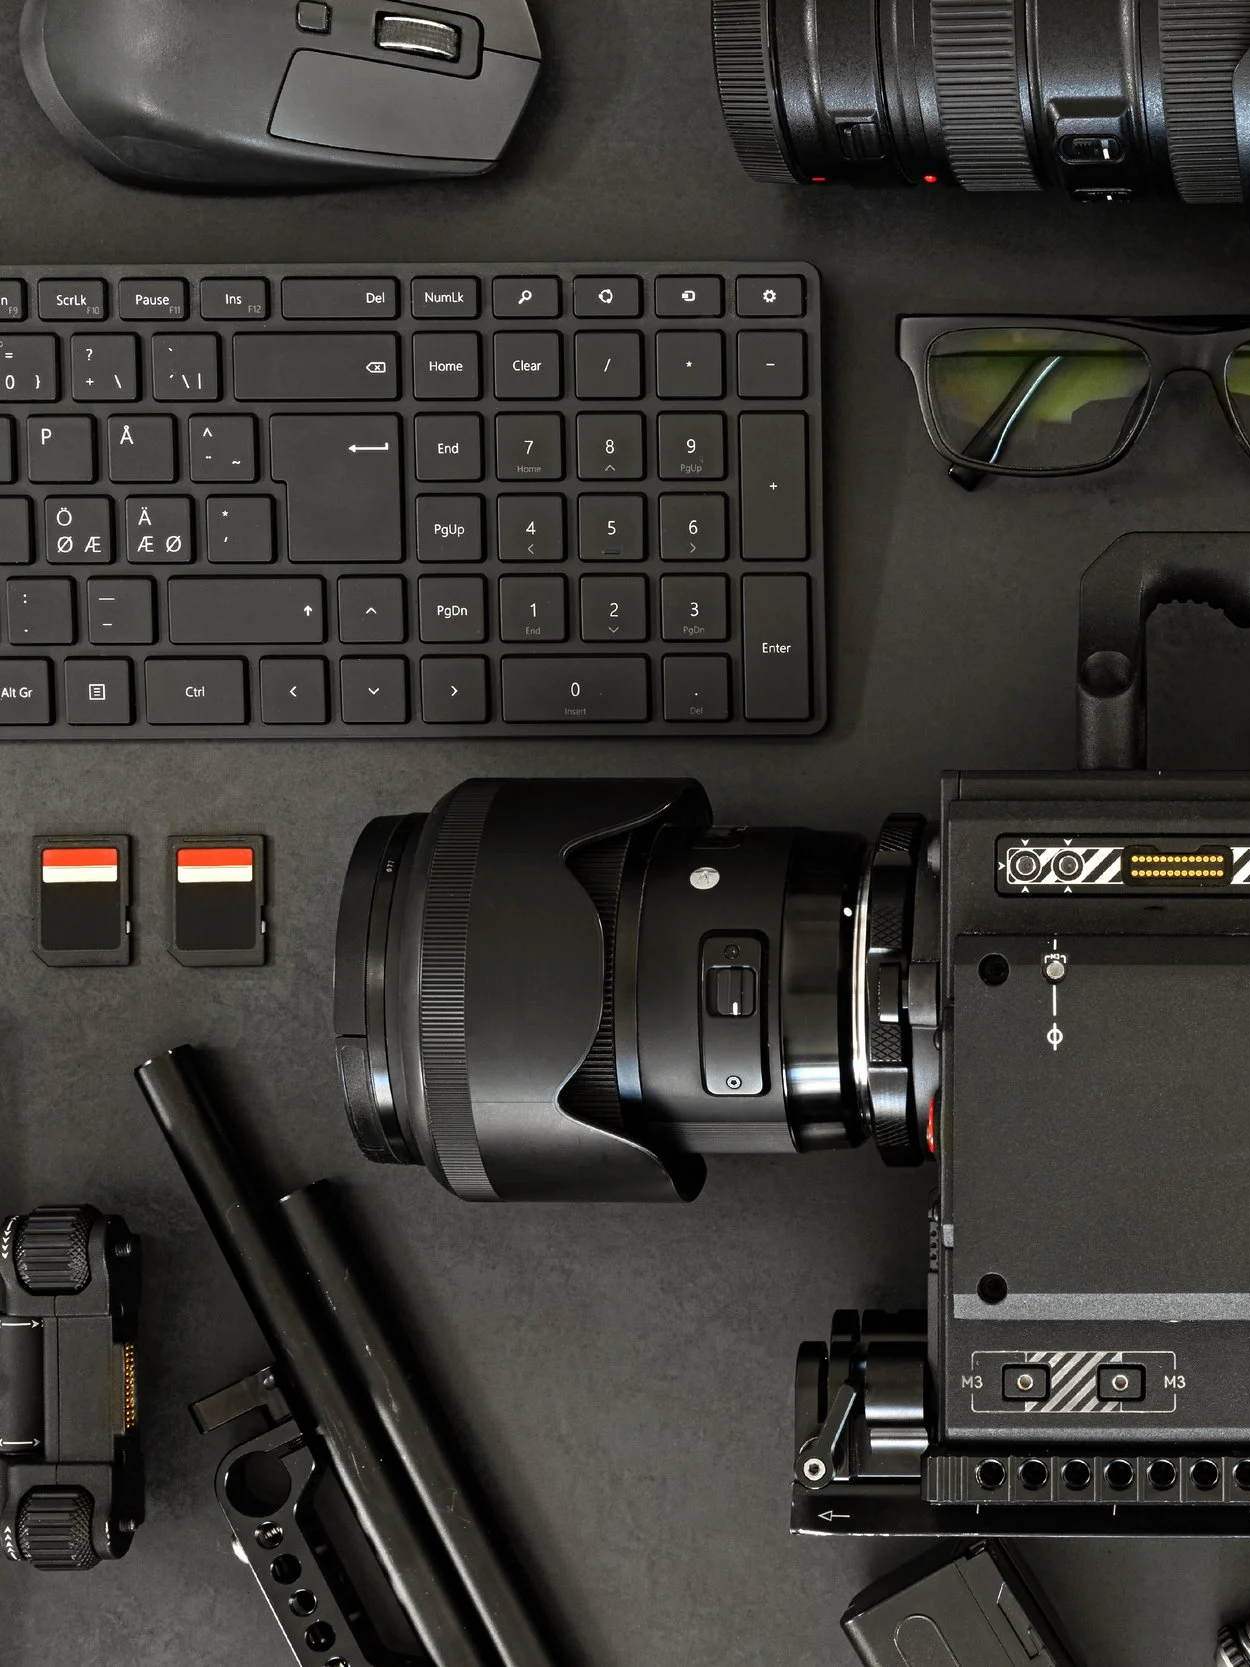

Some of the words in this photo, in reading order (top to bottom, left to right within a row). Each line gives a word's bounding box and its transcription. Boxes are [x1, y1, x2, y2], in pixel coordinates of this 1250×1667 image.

[57, 295, 86, 305] ScrLk
[136, 295, 169, 305] Pause
[226, 294, 241, 304] Ins
[366, 292, 384, 303] Del
[425, 292, 463, 302] NumLk
[8, 306, 18, 314] F9
[248, 305, 261, 313] F12
[86, 348, 92, 360] ?
[430, 361, 463, 371] Home
[513, 360, 541, 371] Clear
[604, 358, 610, 372] /
[42, 428, 51, 445] P
[120, 425, 133, 444] Å
[438, 443, 458, 454] End
[525, 441, 533, 454] 7
[606, 439, 614, 454] 8
[687, 439, 695, 453] 9
[680, 463, 702, 474] PgUp
[57, 507, 72, 526] Ö
[138, 507, 151, 525] Ä
[435, 524, 464, 537] PgUp
[526, 521, 535, 535] 4
[608, 521, 616, 535] 5
[689, 520, 697, 534] 6
[58, 536, 73, 552] Ø
[85, 537, 101, 552] Æ
[137, 536, 154, 552] Æ
[166, 536, 181, 552] Ø
[438, 605, 467, 618] PgDn
[530, 602, 536, 618] 1
[610, 603, 618, 617] 2
[691, 602, 698, 616] 3
[684, 626, 704, 635] PgDn
[763, 643, 791, 653] Enter
[1, 687, 16, 697] Alt
[19, 687, 32, 698] Gr
[186, 687, 204, 697] Ctrl
[571, 682, 580, 696] 0
[962, 1376, 983, 1388] M3
[1165, 1376, 1186, 1388] M3
